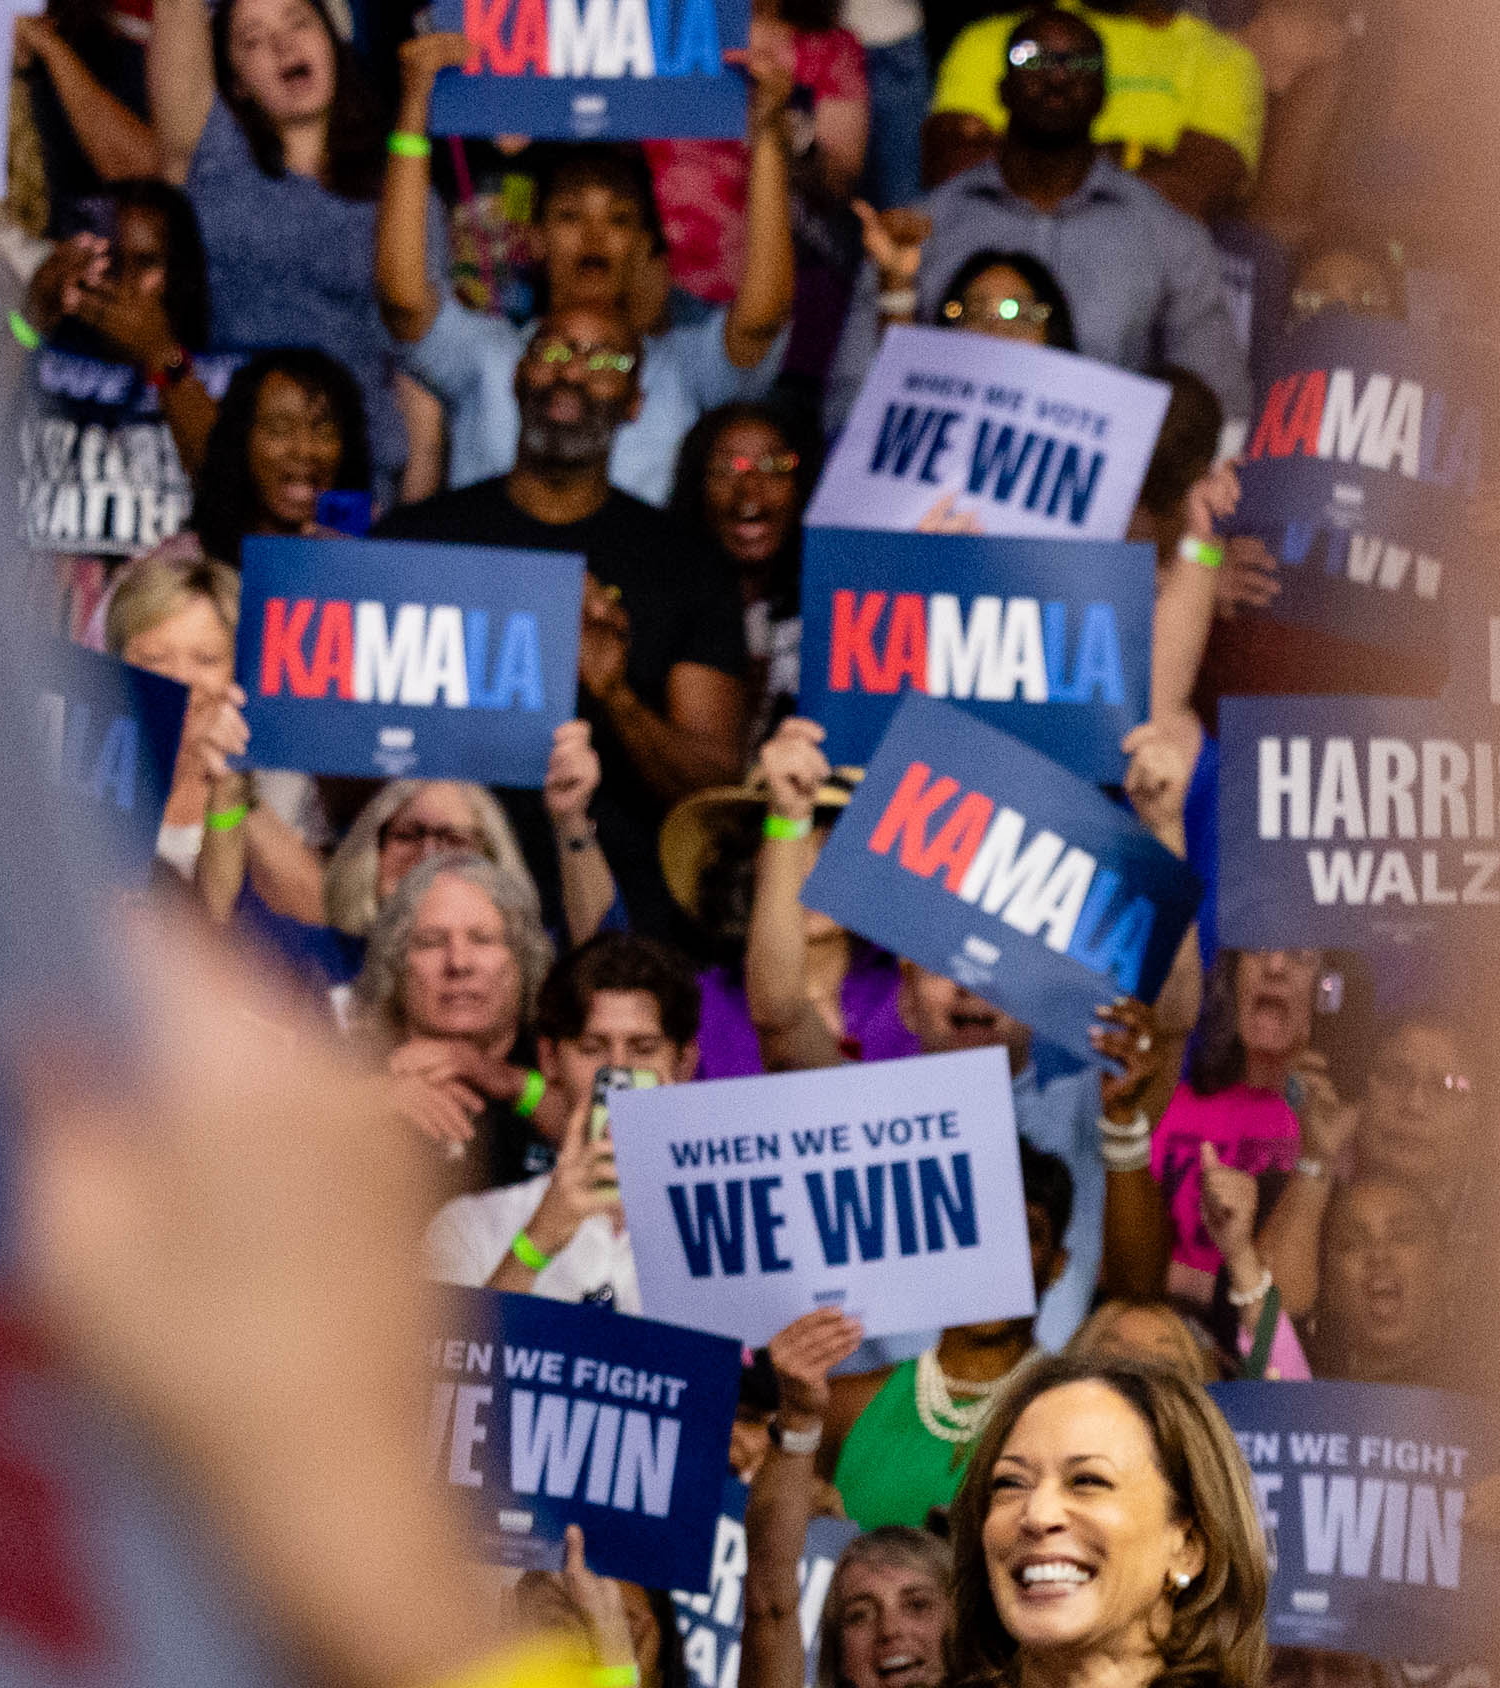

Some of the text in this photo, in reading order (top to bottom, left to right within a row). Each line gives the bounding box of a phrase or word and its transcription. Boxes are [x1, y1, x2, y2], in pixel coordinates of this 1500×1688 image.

[462, 0, 722, 77] KAMALA
[869, 402, 961, 484] WE
[966, 417, 1105, 527] WIN
[1249, 366, 1482, 495] KAMALA
[259, 597, 545, 711] KAMALA
[829, 589, 1125, 705] KAMALA
[868, 761, 1157, 995] KAMALA
[670, 1110, 960, 1168] WHEN WE VOTE
[666, 1152, 979, 1278] WE WIN
[432, 1338, 687, 1409] EN WE FIGHT
[510, 1387, 682, 1518] WIN
[1236, 1432, 1469, 1479] EN WE FIGHT
[1301, 1473, 1465, 1590] WIN
